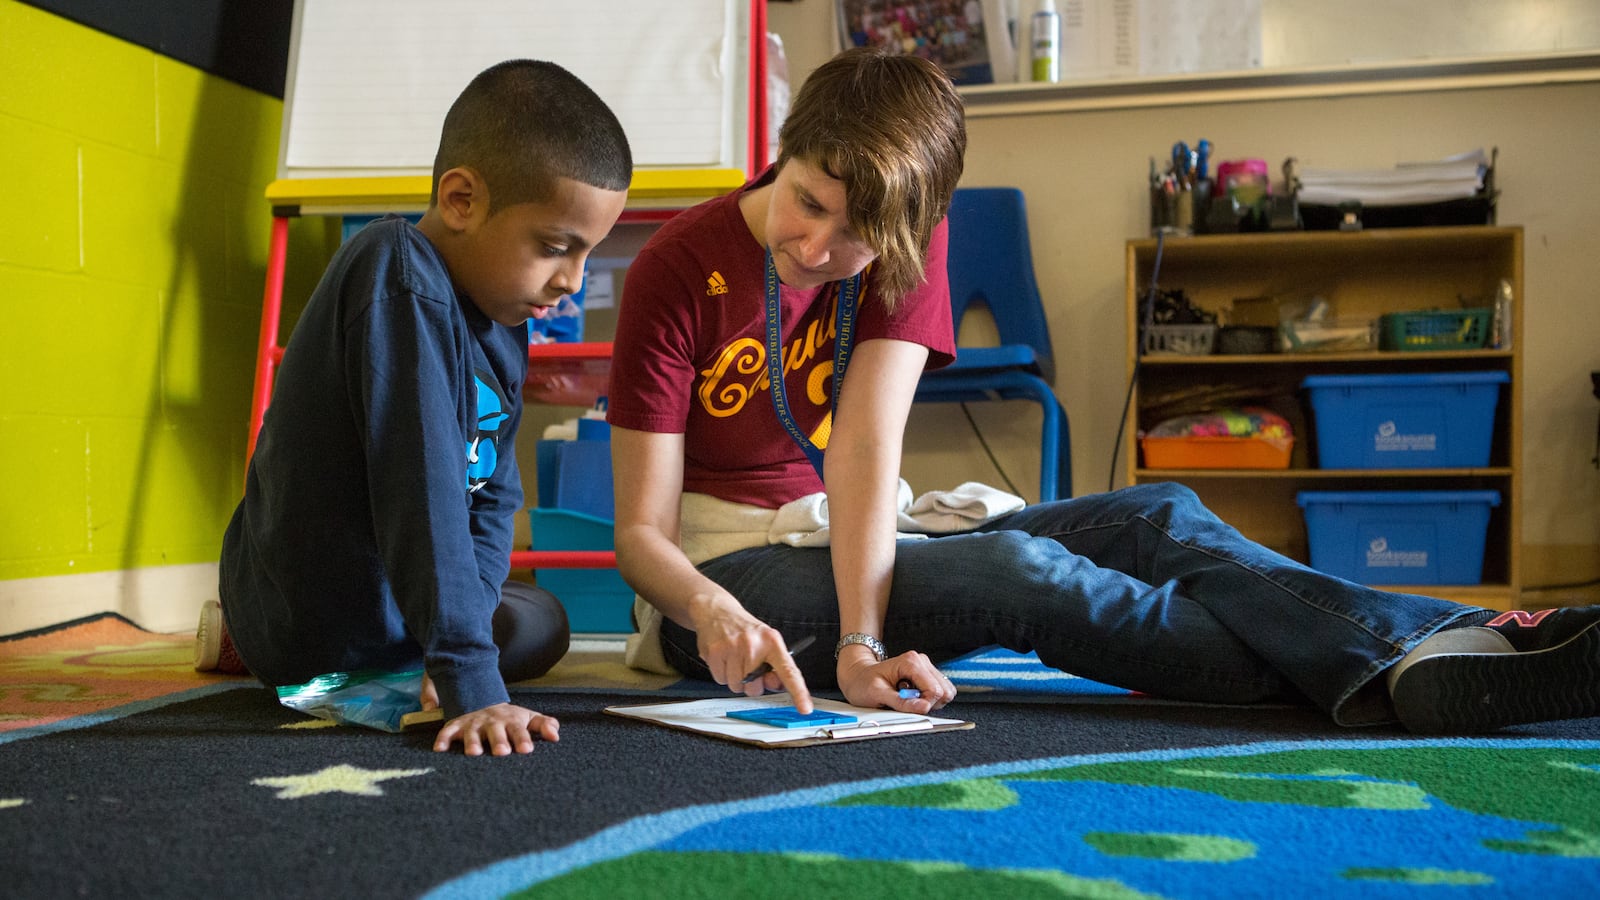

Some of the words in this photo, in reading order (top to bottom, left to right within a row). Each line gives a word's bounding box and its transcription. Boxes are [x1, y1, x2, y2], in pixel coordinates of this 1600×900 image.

[769, 300, 777, 324] CITY
[841, 309, 853, 347] PUBLIC
[770, 327, 779, 366] PUBLIC
[837, 349, 848, 374] CITY
[772, 367, 787, 416] CHARTER
[783, 417, 810, 448] SCHOOL
